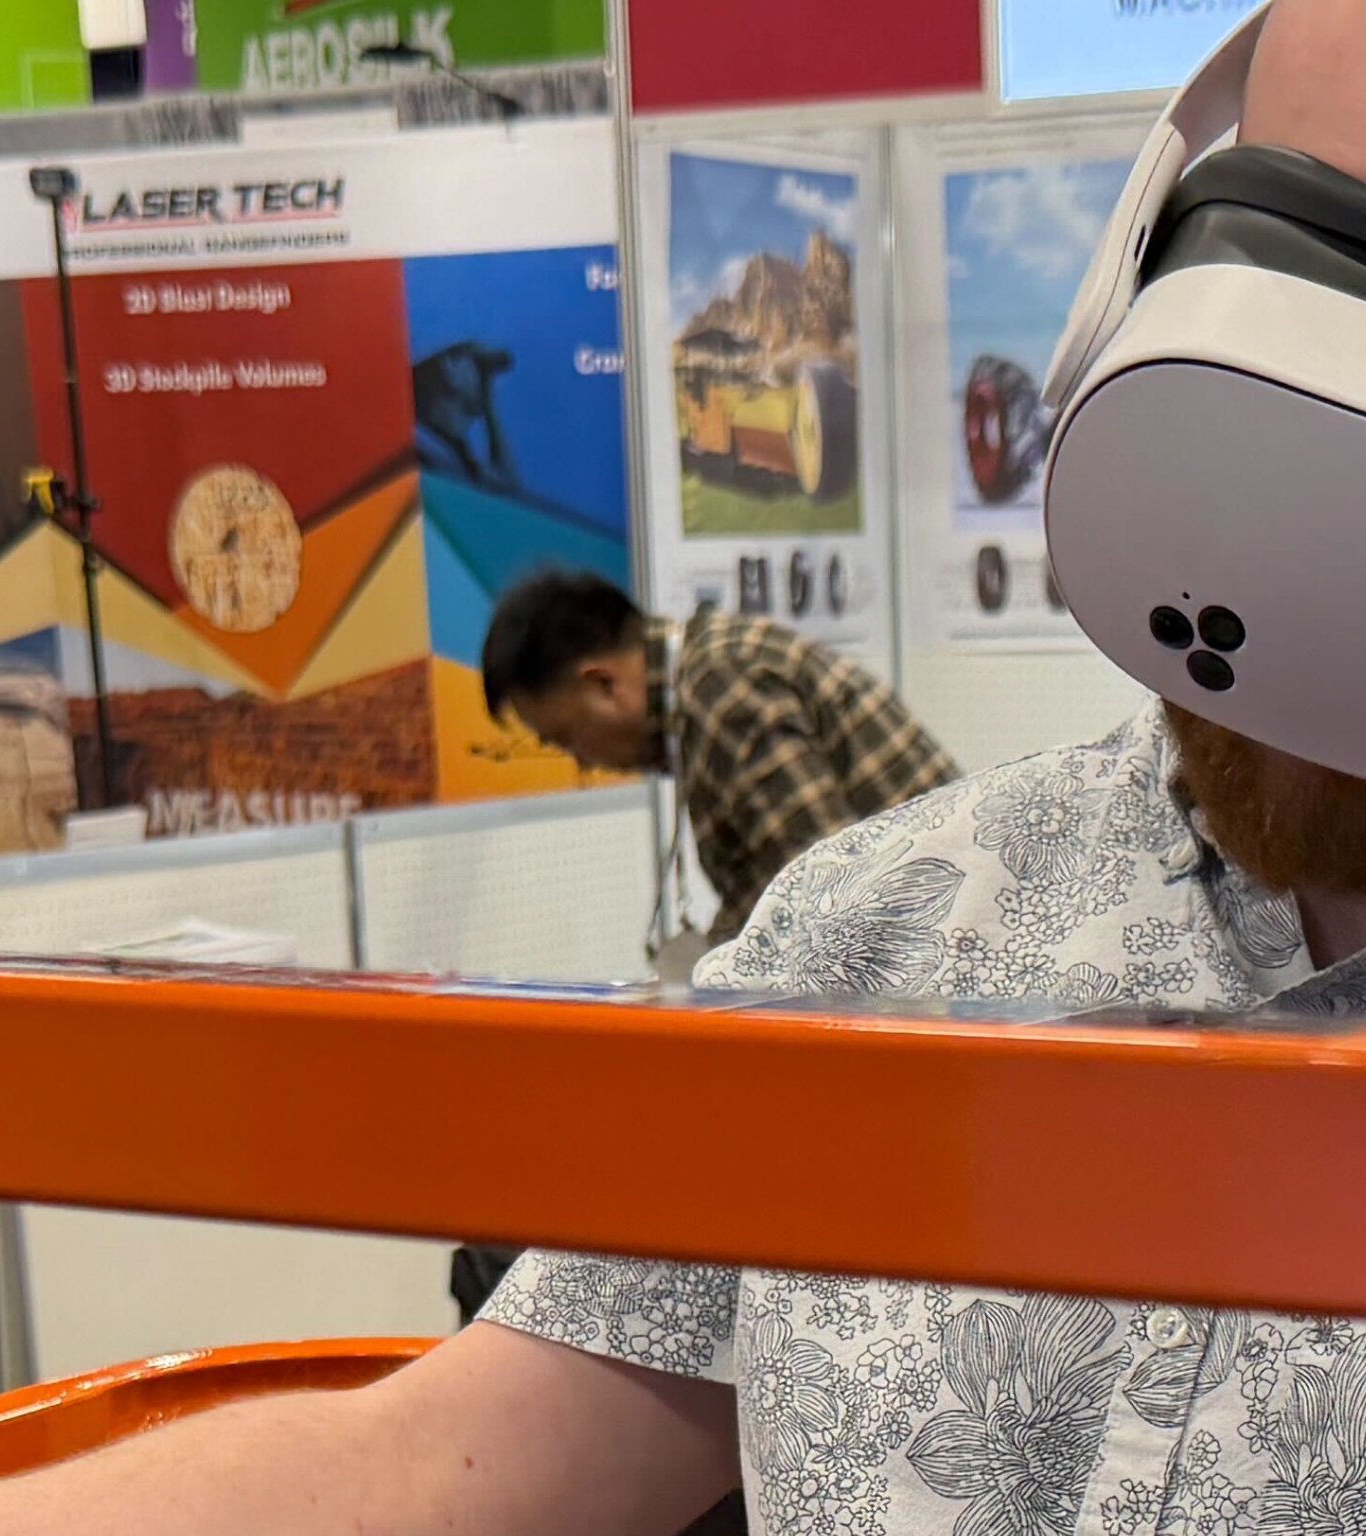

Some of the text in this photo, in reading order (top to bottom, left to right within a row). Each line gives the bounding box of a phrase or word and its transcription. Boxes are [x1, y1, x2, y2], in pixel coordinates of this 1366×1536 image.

[82, 178, 344, 224] LASER TECH
[63, 239, 194, 262] ROFESSIONAL
[214, 280, 291, 314] Design
[137, 361, 232, 396] Stockpile
[235, 359, 327, 388] Volumes
